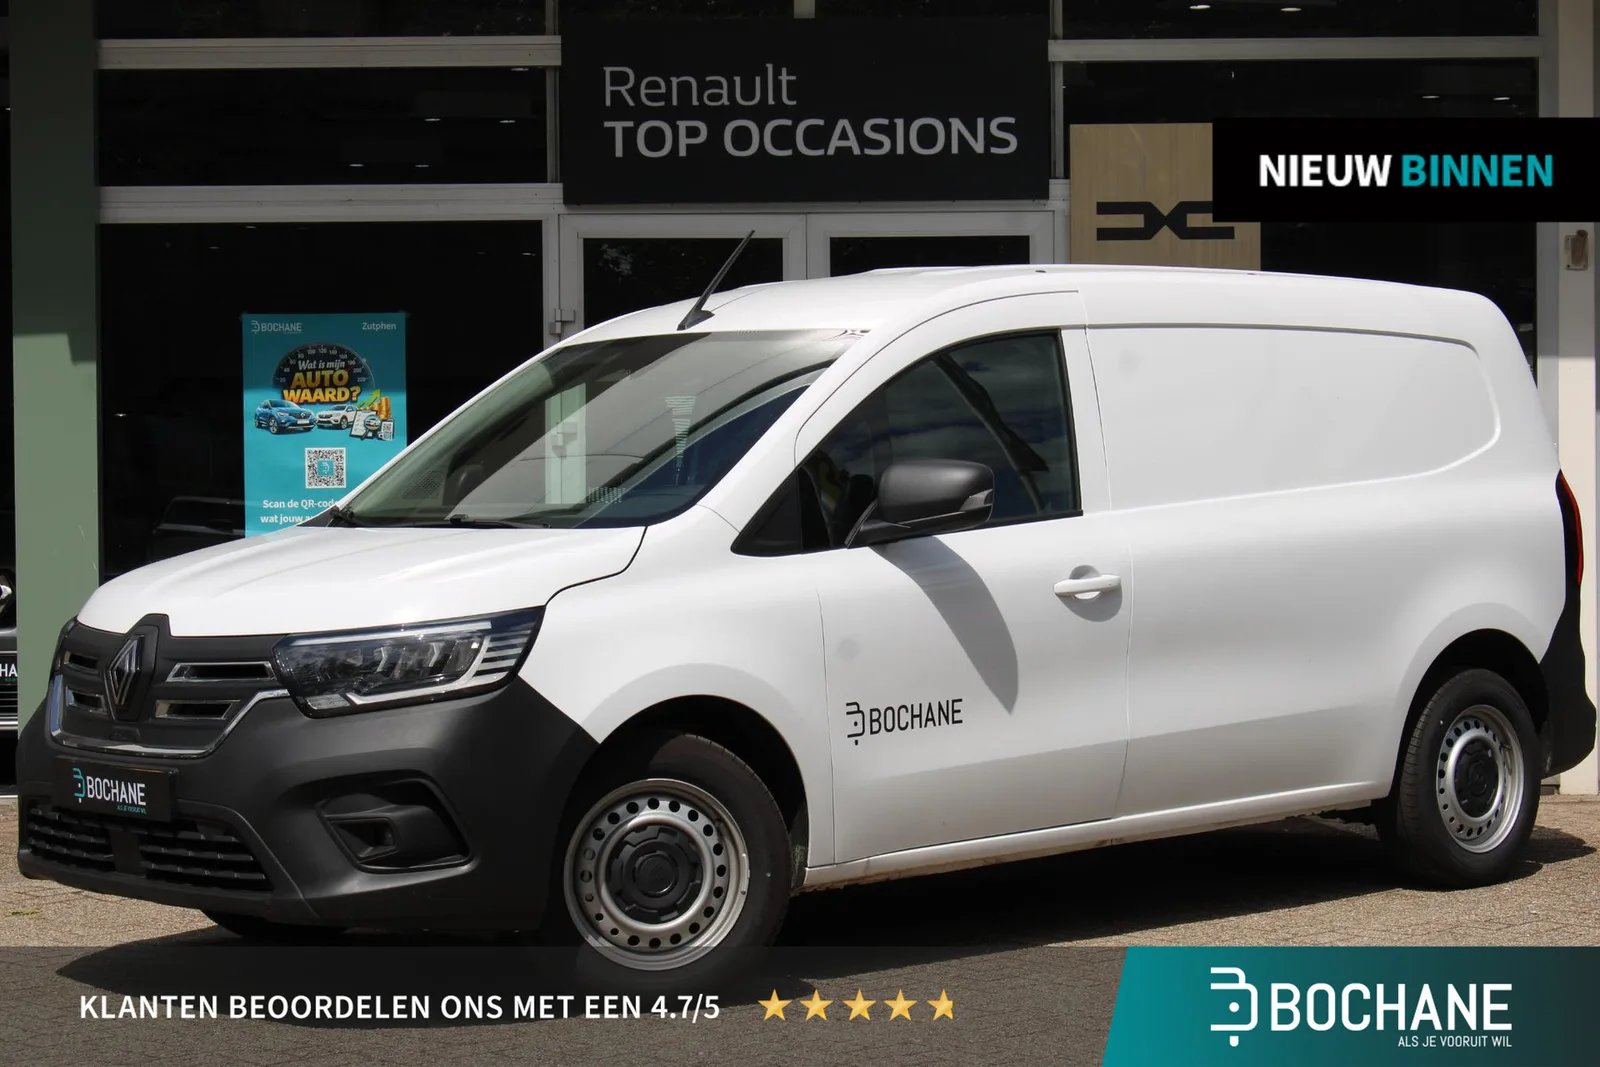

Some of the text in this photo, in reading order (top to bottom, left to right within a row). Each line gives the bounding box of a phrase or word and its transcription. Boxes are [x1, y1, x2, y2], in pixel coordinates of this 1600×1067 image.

[603, 63, 797, 107] Renault
[603, 116, 1018, 158] TOP OCCASIONS
[261, 322, 303, 332] BOCHANE
[362, 321, 397, 331] Zutphen
[298, 359, 317, 371] Wat
[318, 360, 326, 369] is
[326, 359, 346, 371] mijn
[290, 369, 349, 389] AUTO
[282, 386, 361, 404] WAARD?
[262, 499, 286, 509] Scan
[287, 499, 299, 508] de
[260, 514, 279, 524] wat
[279, 513, 303, 525] jouw
[869, 698, 963, 735] BOCHANE
[86, 775, 147, 806] BOCHANE
